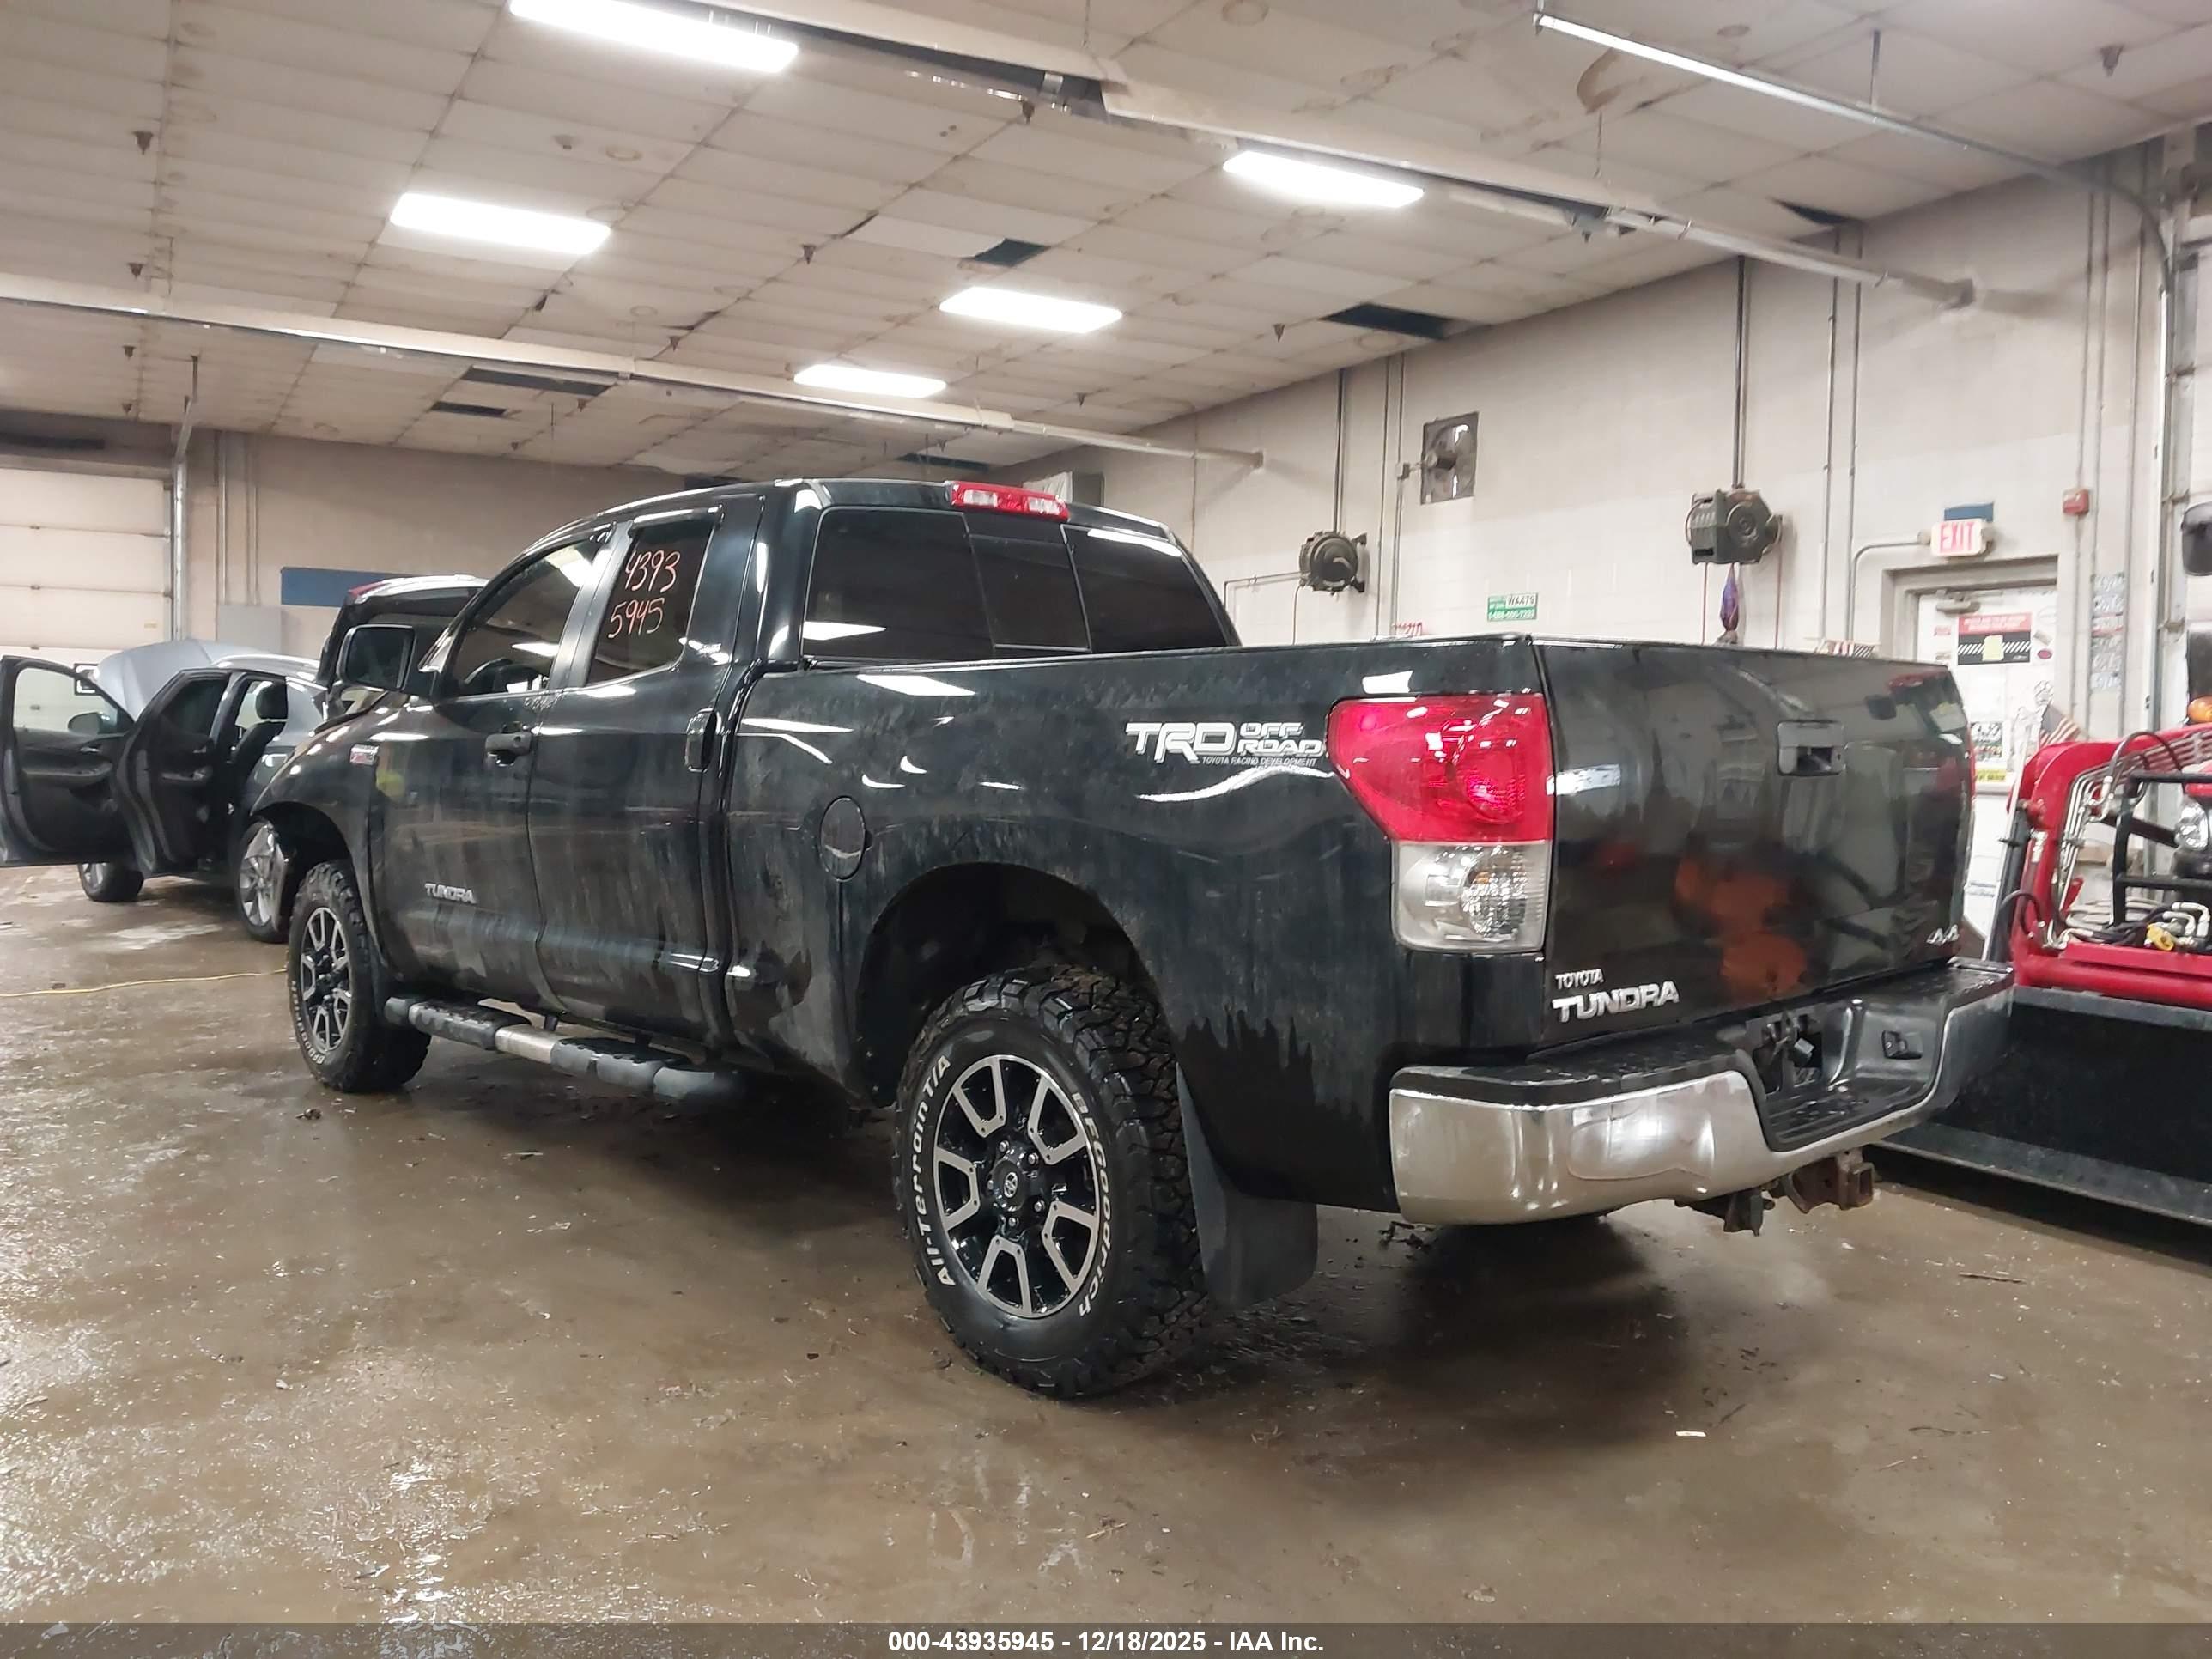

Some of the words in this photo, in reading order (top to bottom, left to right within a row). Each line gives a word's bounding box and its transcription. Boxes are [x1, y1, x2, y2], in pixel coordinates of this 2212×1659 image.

[1939, 520, 1976, 554] EXIT
[624, 550, 681, 593] 4393
[607, 597, 665, 639] 5945
[1125, 721, 1237, 764] TRD
[1237, 738, 1325, 757] ROAD
[1239, 721, 1305, 740] OFF
[1202, 756, 1230, 765] TOYOTA
[1231, 756, 1260, 766] RACING
[1260, 756, 1318, 768] DEVELOPMENT
[424, 882, 477, 904] TUNDRA
[1554, 968, 1605, 990] TOYOTA
[1551, 980, 1680, 1023] TUNDRA
[922, 1054, 951, 1098] T/A
